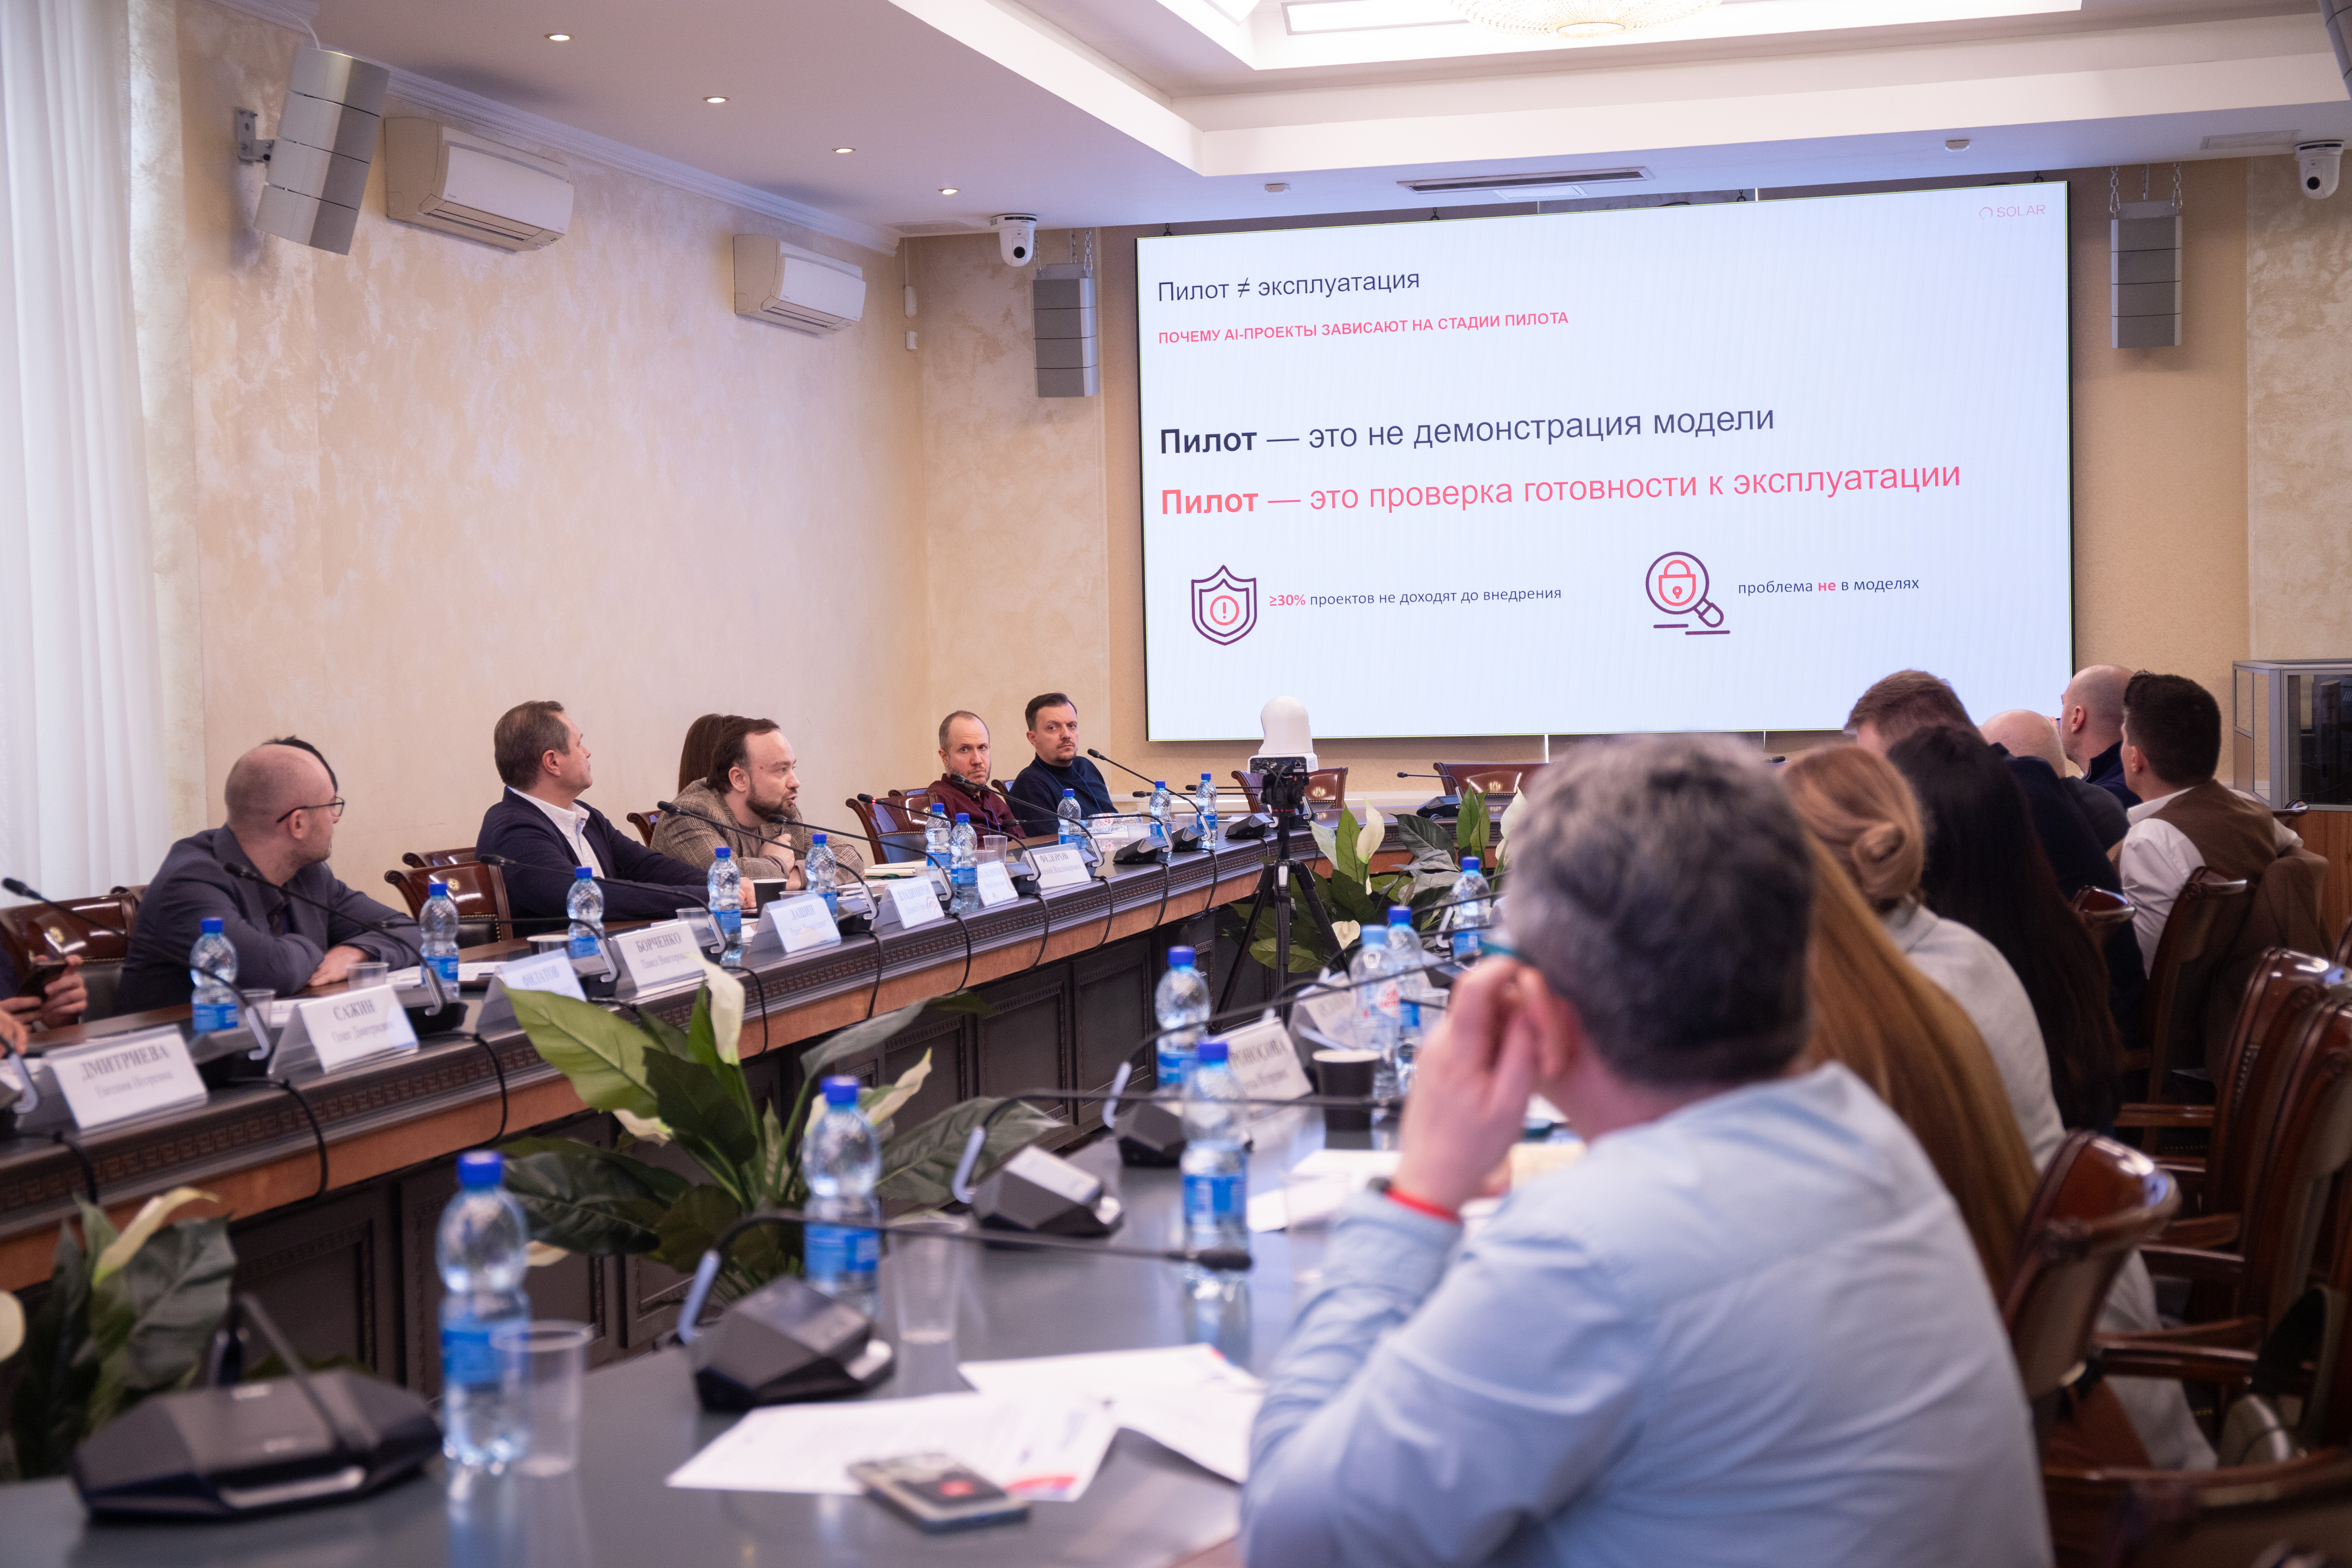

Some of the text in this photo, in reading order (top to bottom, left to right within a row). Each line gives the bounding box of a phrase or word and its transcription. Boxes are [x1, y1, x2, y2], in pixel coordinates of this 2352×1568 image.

[1997, 205, 2046, 217] SOLAR
[1158, 281, 1230, 302] Пилот
[1258, 273, 1420, 299] эксплуатация
[1158, 311, 1569, 344] ПОЧЕМУ AI-ПРОЕКТЫ ЗАВИСАЮТ НА СТАДИИ ПИЛОТА
[1160, 428, 1258, 455] Пилот
[1309, 427, 1358, 449] это
[1369, 425, 1404, 446] не
[1413, 415, 1642, 450] демонстрация
[1654, 409, 1774, 438] модели
[1162, 489, 1259, 515] Пилот
[1310, 488, 1359, 510] это
[1370, 483, 1513, 514] проверка
[1524, 476, 1697, 502] готовности
[1709, 475, 1724, 496] к
[1733, 466, 1960, 499] эксплуатации
[1269, 589, 1562, 608] ≥30% проектов не доходят до внедрения
[1738, 579, 1920, 597] проблема не в моделях
[1039, 852, 1069, 863] ФЕДОРОВ
[635, 932, 681, 953] БОРЧЕНКО
[522, 965, 560, 988] ФИЛАТОВ
[332, 998, 376, 1022] САЖИН
[80, 1044, 170, 1082] ДМИТРИЕВА
